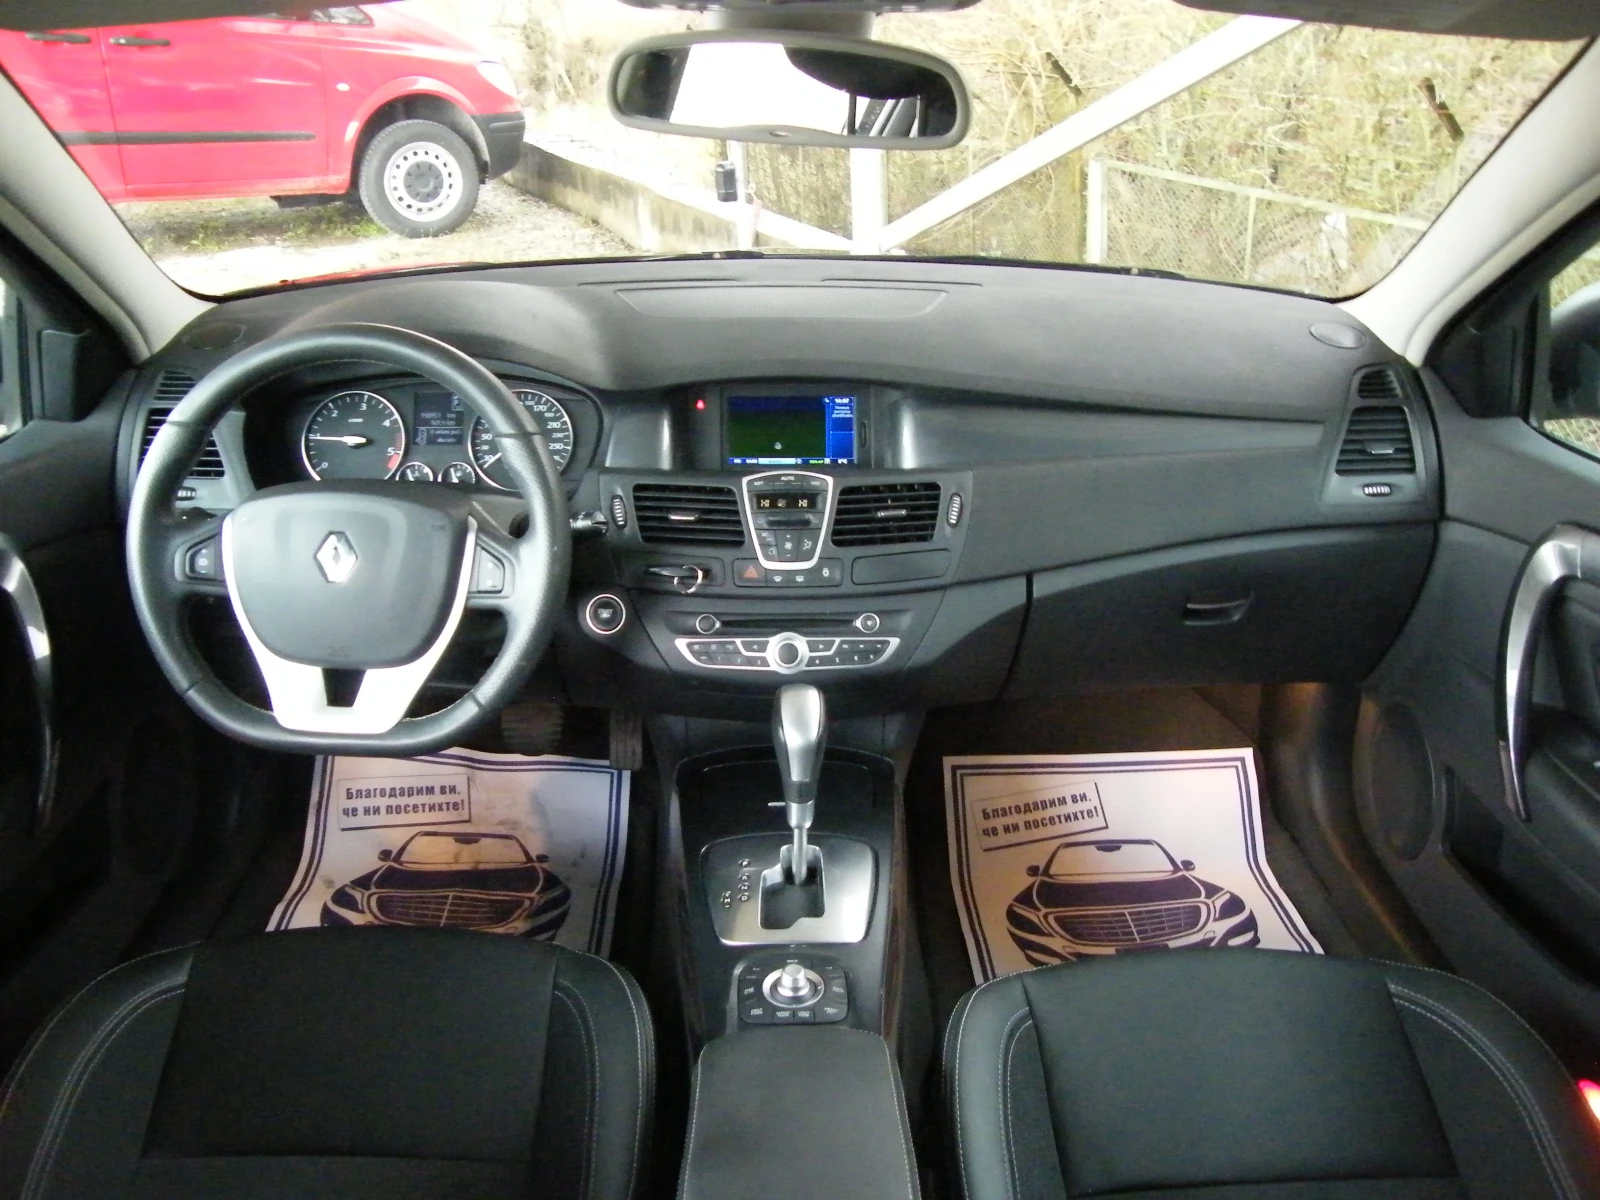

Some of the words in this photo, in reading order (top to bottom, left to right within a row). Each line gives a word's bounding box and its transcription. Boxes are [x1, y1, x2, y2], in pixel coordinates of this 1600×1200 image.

[387, 447, 395, 456] 5
[321, 461, 328, 469] 0
[346, 785, 435, 800] Благодарим
[342, 806, 358, 817] че
[363, 805, 380, 816] ни
[386, 799, 465, 815] посетихте!
[981, 796, 1067, 820] Благодарим
[982, 826, 999, 838] че
[1002, 823, 1020, 834] ни
[1023, 805, 1099, 830] посетихте!
